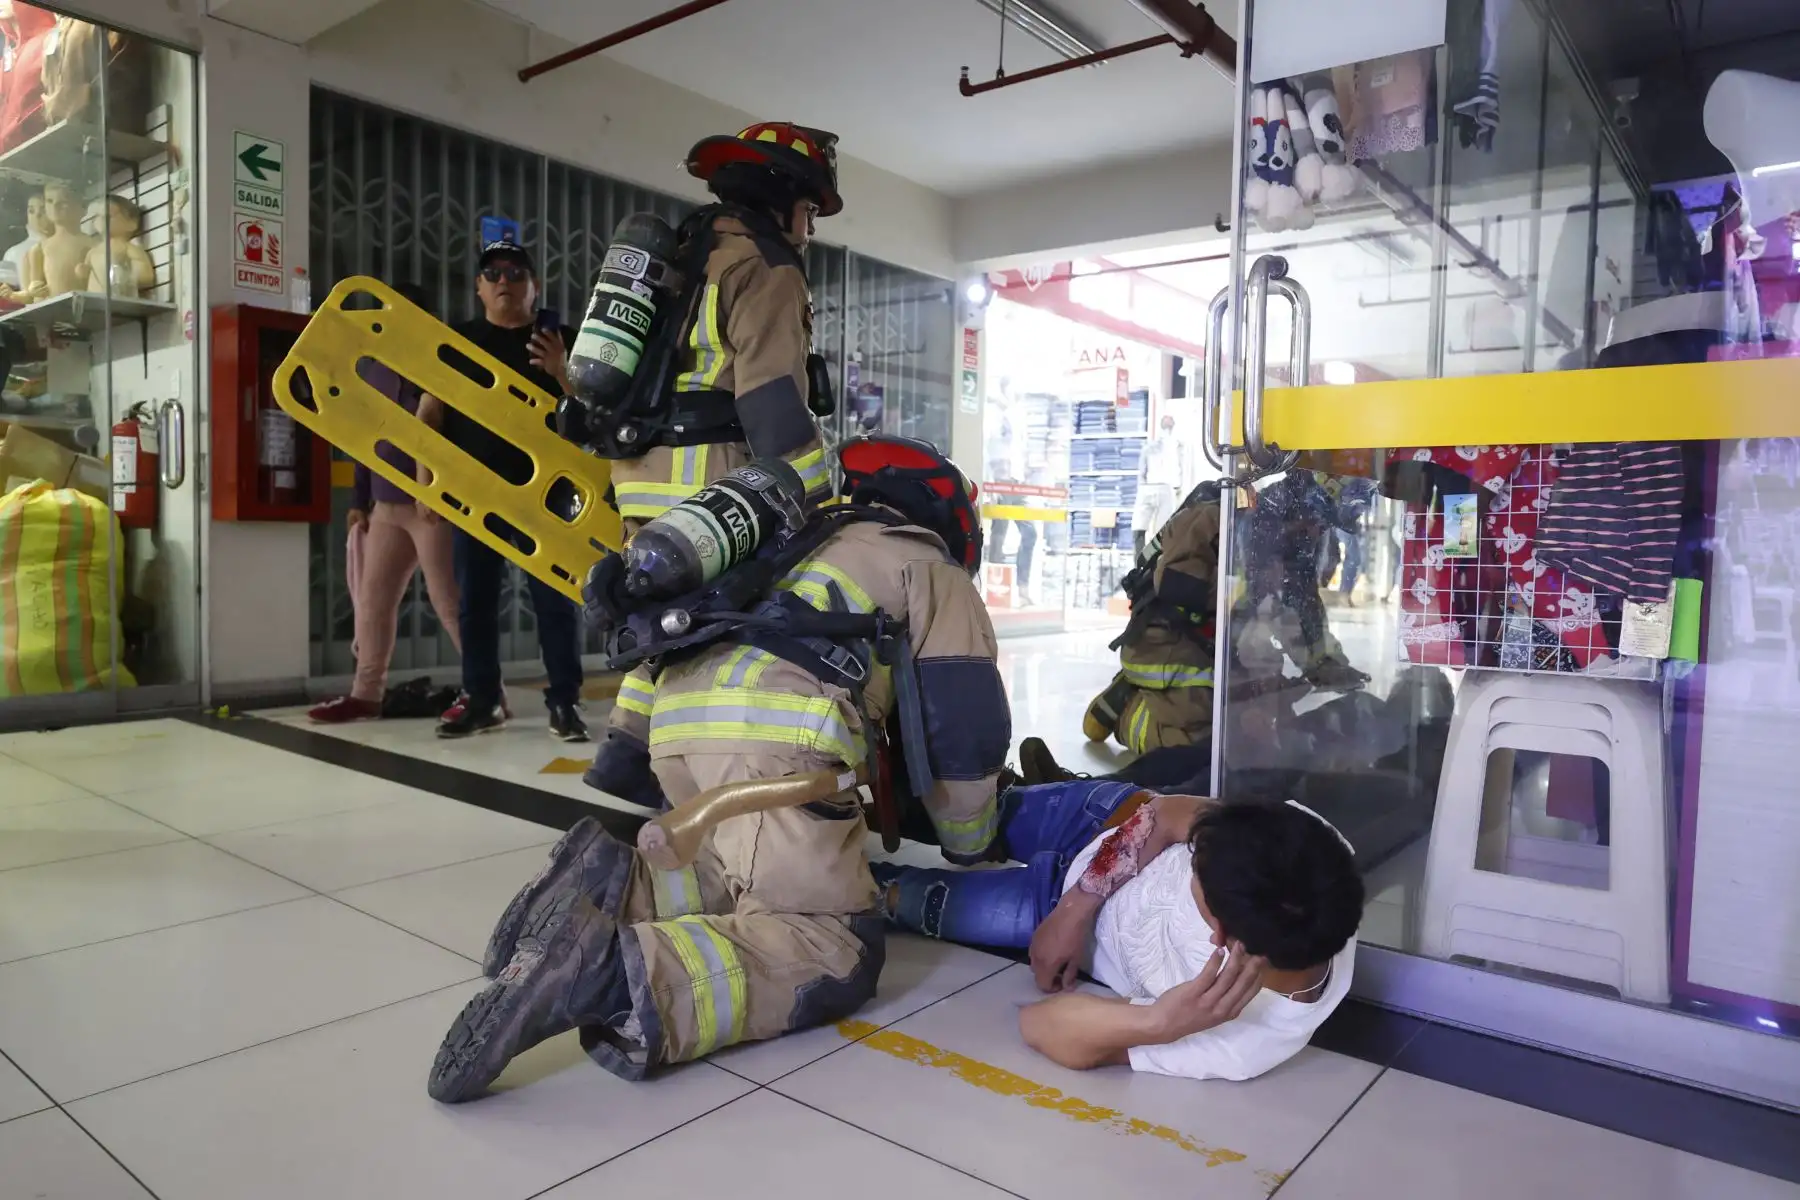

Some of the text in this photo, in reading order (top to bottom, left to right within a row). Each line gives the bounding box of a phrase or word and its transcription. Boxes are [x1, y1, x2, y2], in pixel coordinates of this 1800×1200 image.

[238, 190, 280, 209] SALIDA
[620, 254, 639, 271] G1
[238, 269, 280, 287] EXTINTOR
[610, 303, 650, 333] MSA
[727, 512, 750, 557] MS
